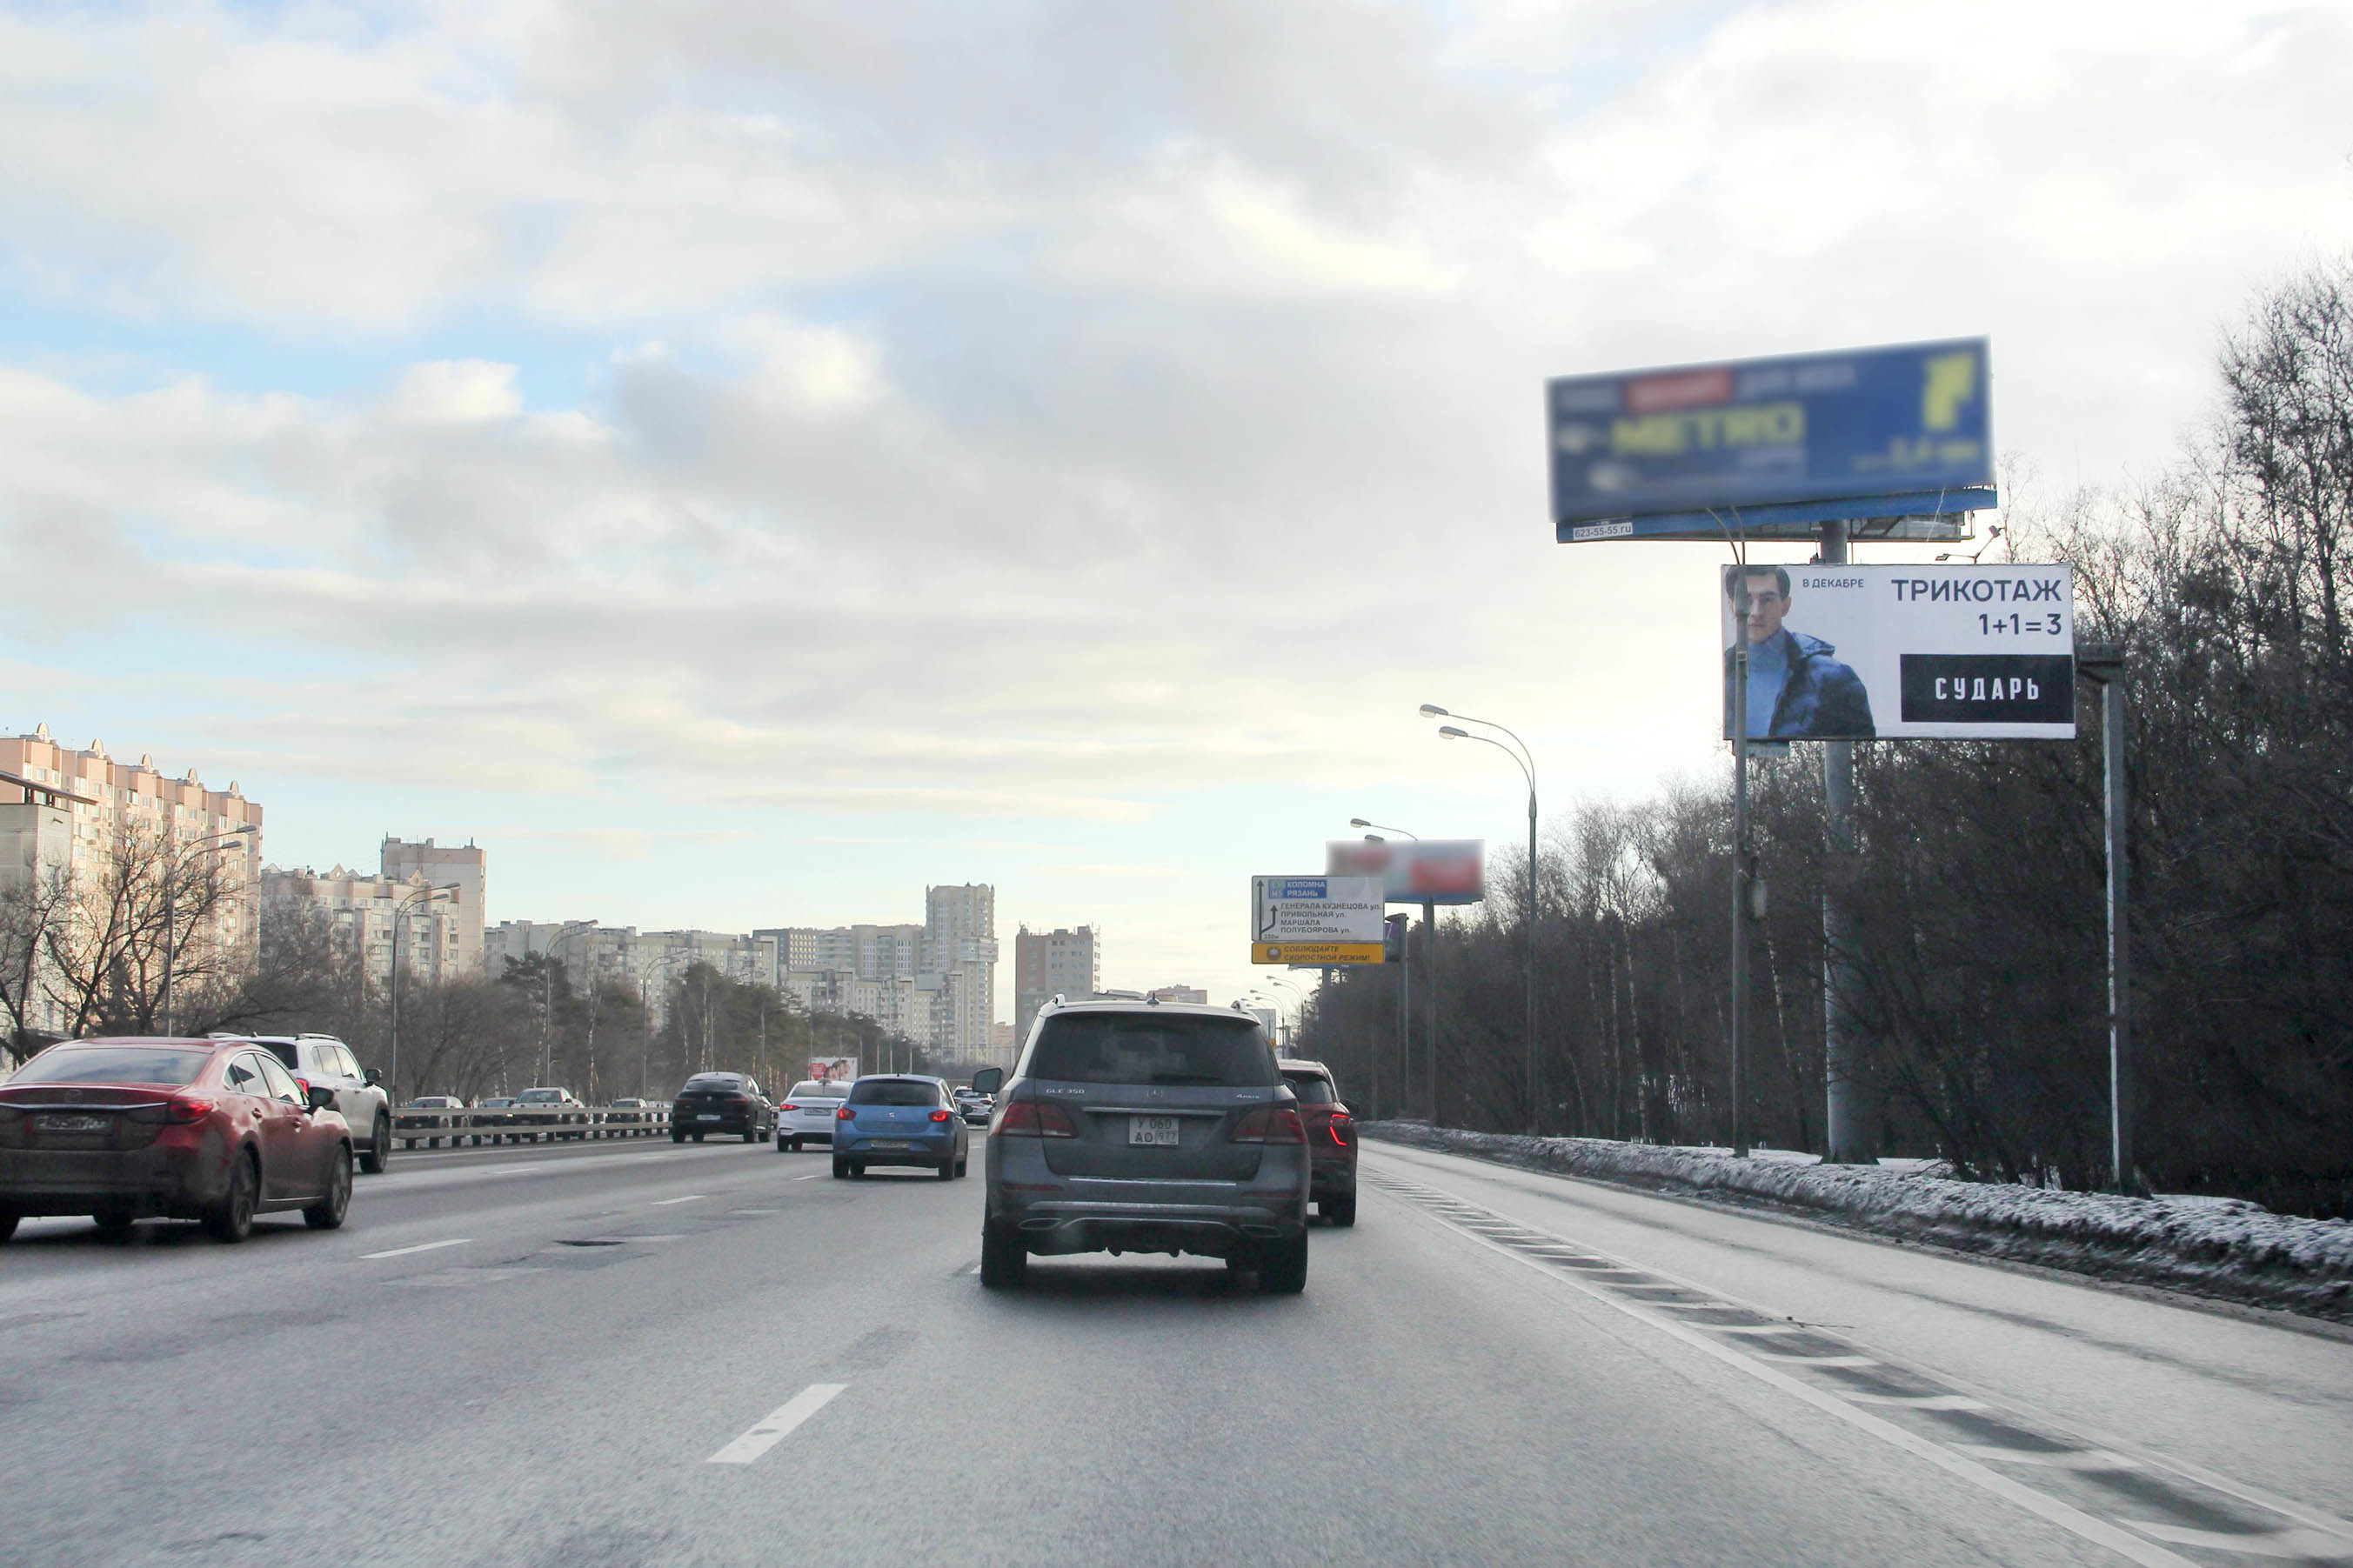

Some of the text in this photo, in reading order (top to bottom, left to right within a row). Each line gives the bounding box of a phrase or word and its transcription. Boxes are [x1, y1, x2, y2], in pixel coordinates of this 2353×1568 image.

[1802, 578, 1865, 590] В ДЕКАБРЕ
[1890, 578, 2062, 602] ТРИКОТАЖ
[1978, 612, 2062, 636] 1+1=3
[1934, 677, 2040, 701] СУДАРЬ
